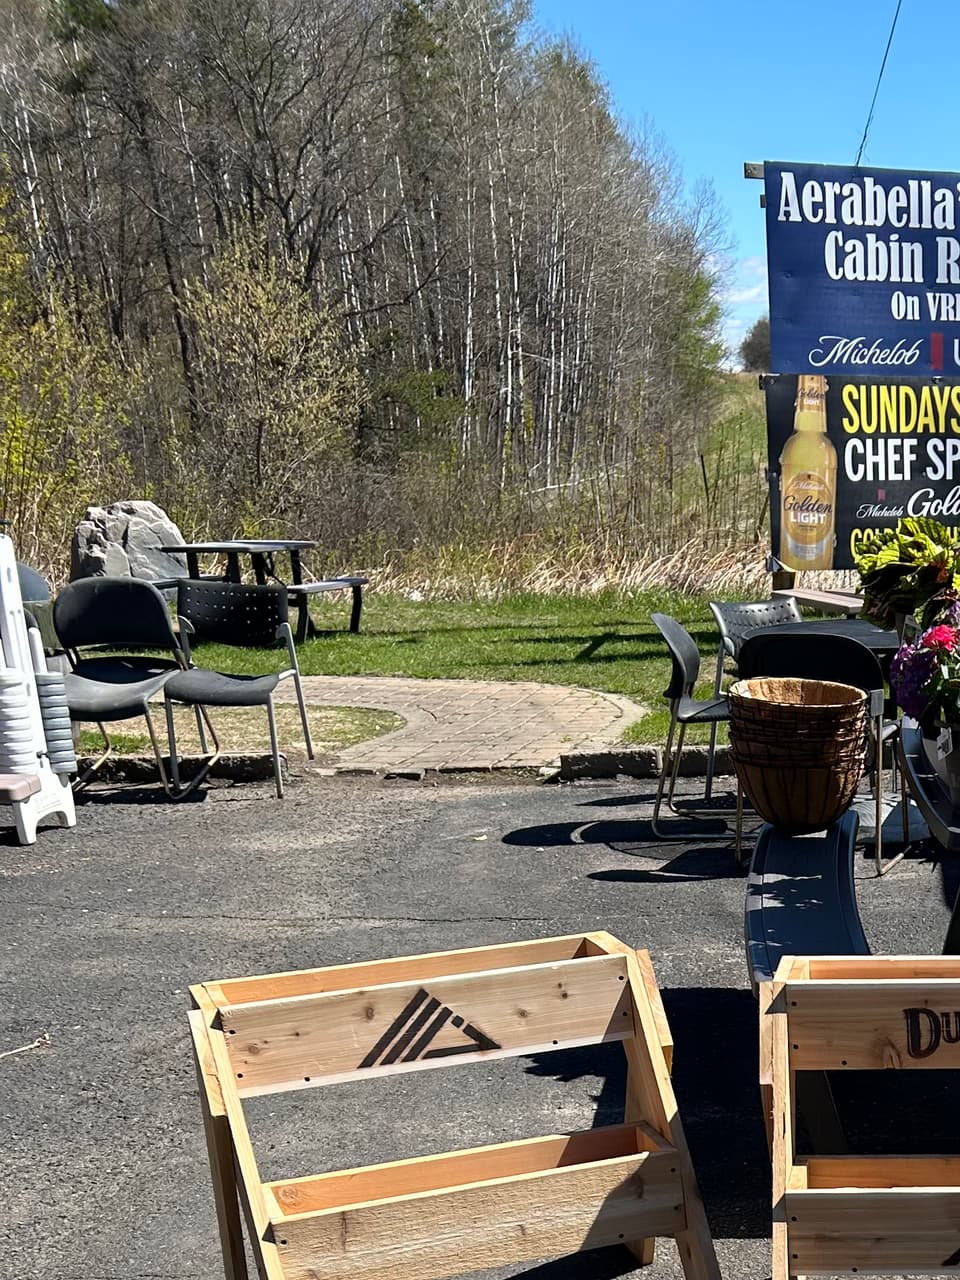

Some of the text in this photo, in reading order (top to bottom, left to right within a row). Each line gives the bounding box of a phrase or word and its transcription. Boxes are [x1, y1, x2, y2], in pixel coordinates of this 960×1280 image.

[825, 231, 924, 283] Cabin
[891, 291, 920, 321] On
[808, 336, 920, 367] Michelob
[844, 439, 918, 482] CHEF
[783, 495, 833, 513] Golden
[790, 511, 826, 524] LIGHT
